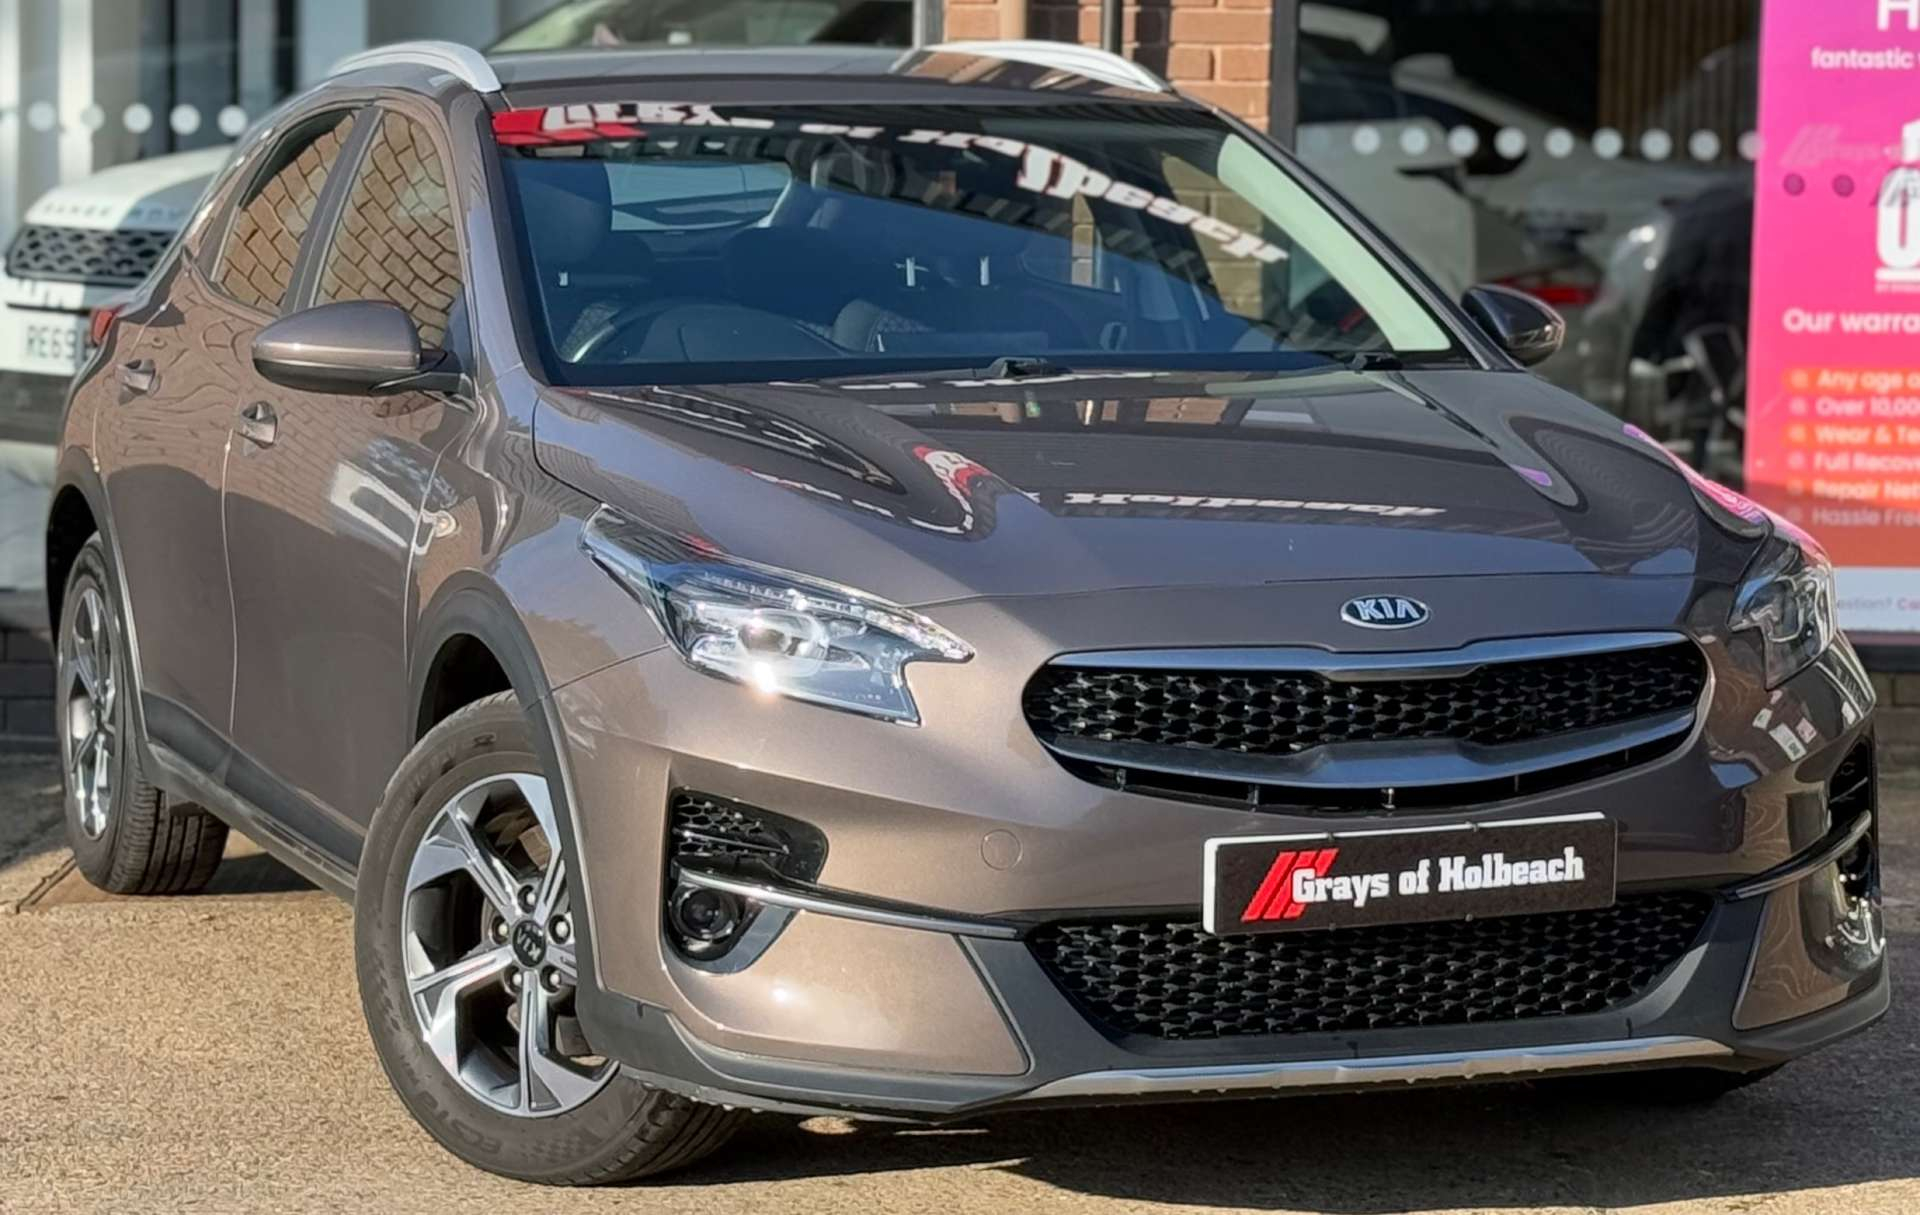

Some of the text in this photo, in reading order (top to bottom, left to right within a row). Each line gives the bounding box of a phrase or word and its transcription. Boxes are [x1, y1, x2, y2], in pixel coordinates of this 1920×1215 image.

[1810, 46, 1915, 70] fantastic
[1782, 308, 1834, 333] Our
[1817, 369, 1858, 392] Any
[1860, 372, 1903, 394] age
[1815, 397, 1865, 417] Over
[1814, 425, 1871, 445] Wear
[1874, 425, 1891, 445] &
[1812, 452, 1849, 471] Full
[1811, 479, 1878, 502] Repair
[1811, 506, 1880, 528] Hassle
[1352, 598, 1420, 621] KIA
[1292, 846, 1586, 907] Grays of Holbeach
